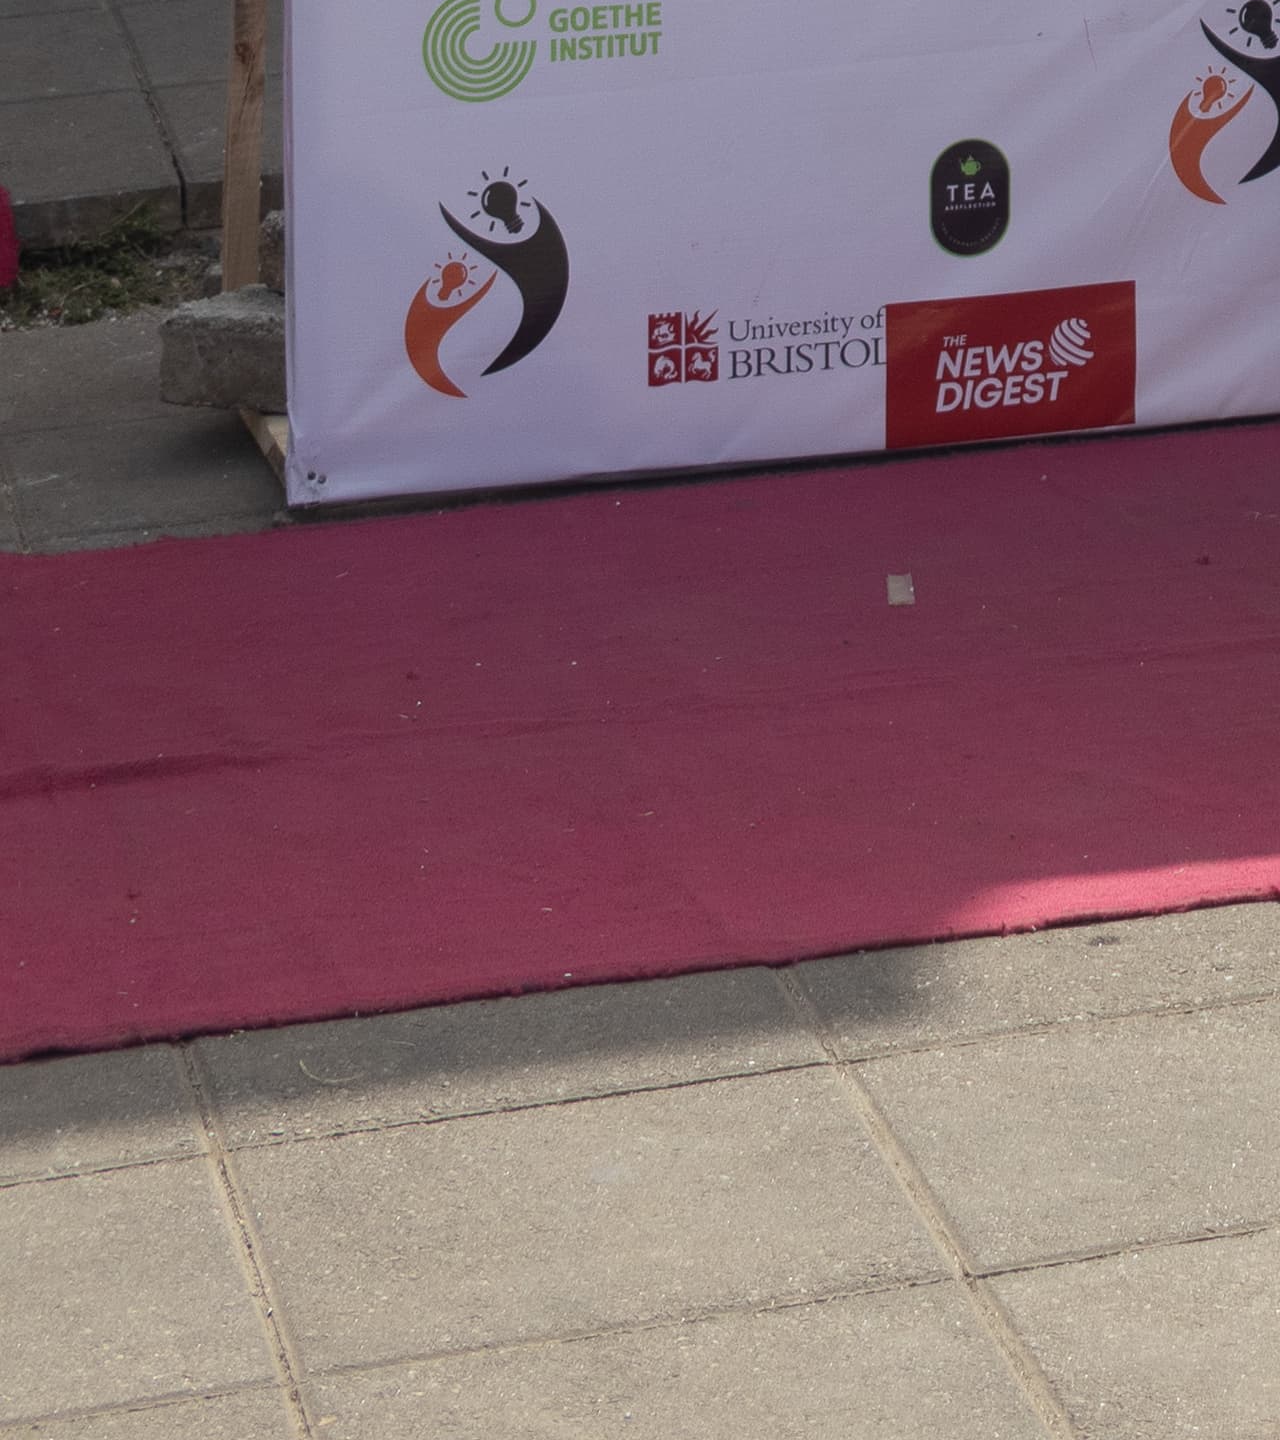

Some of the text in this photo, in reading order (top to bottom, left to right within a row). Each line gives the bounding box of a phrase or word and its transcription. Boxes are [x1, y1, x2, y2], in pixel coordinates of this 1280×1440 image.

[549, 2, 661, 32] GOETHE
[550, 32, 662, 62] INSTITUT
[947, 182, 994, 202] TEA
[730, 306, 884, 341] University of
[944, 335, 966, 346] THE
[728, 337, 884, 379] BRISTOL
[936, 341, 1043, 379] NEWS
[936, 371, 1068, 412] DIGEST
